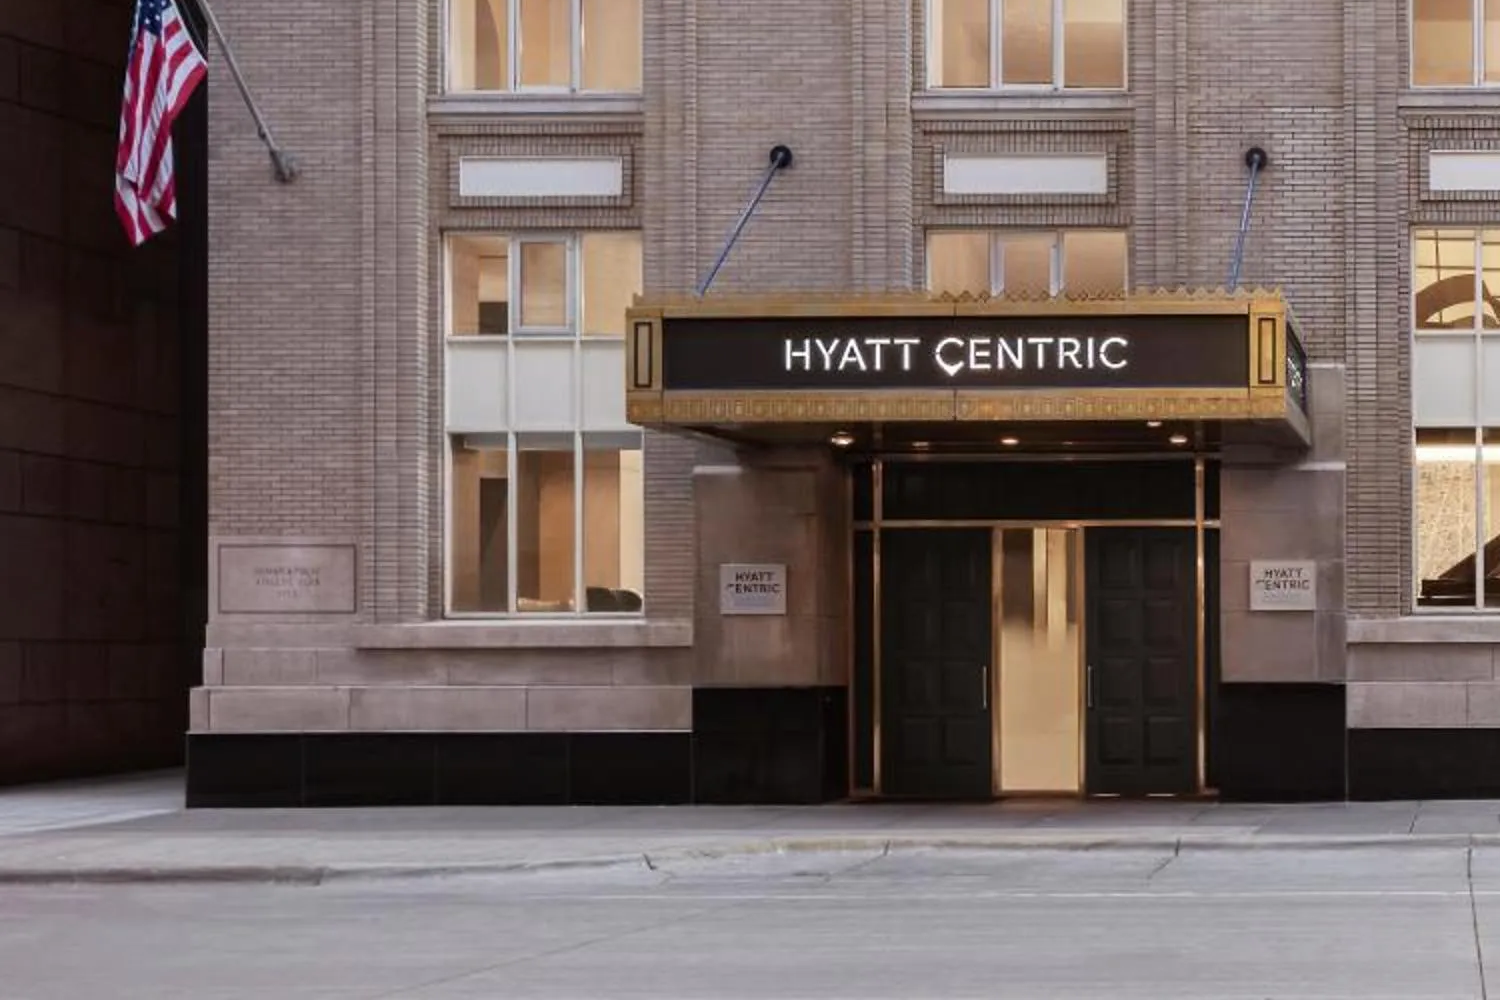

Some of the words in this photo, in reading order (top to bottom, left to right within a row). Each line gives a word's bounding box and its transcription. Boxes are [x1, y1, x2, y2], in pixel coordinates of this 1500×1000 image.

[784, 337, 920, 371] HYATT
[934, 336, 1128, 376] CENTRIC
[735, 571, 775, 582] HYATT
[1264, 567, 1303, 579] HYATT
